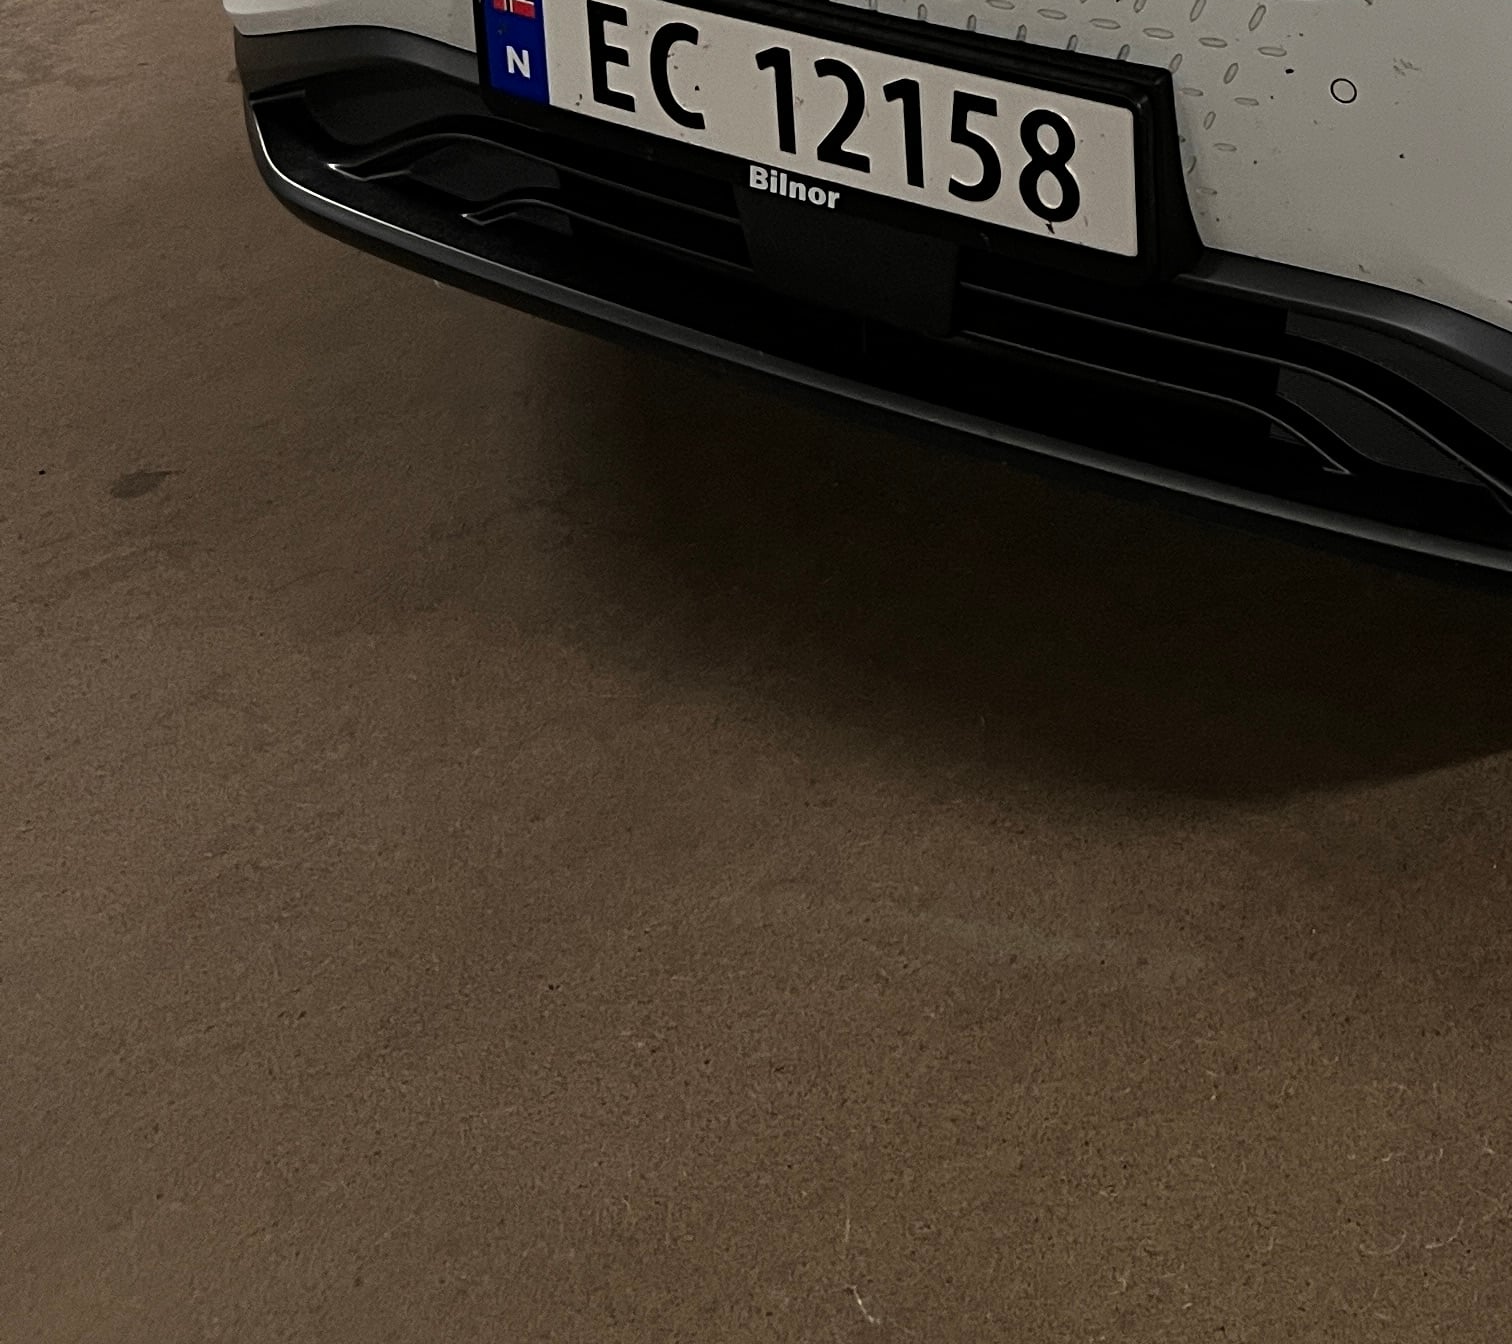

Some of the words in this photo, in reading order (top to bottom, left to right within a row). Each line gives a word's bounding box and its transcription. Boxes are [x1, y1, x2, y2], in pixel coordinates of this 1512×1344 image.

[505, 45, 531, 79] N
[754, 46, 1082, 224] 12158
[749, 164, 840, 209] Bilnor
